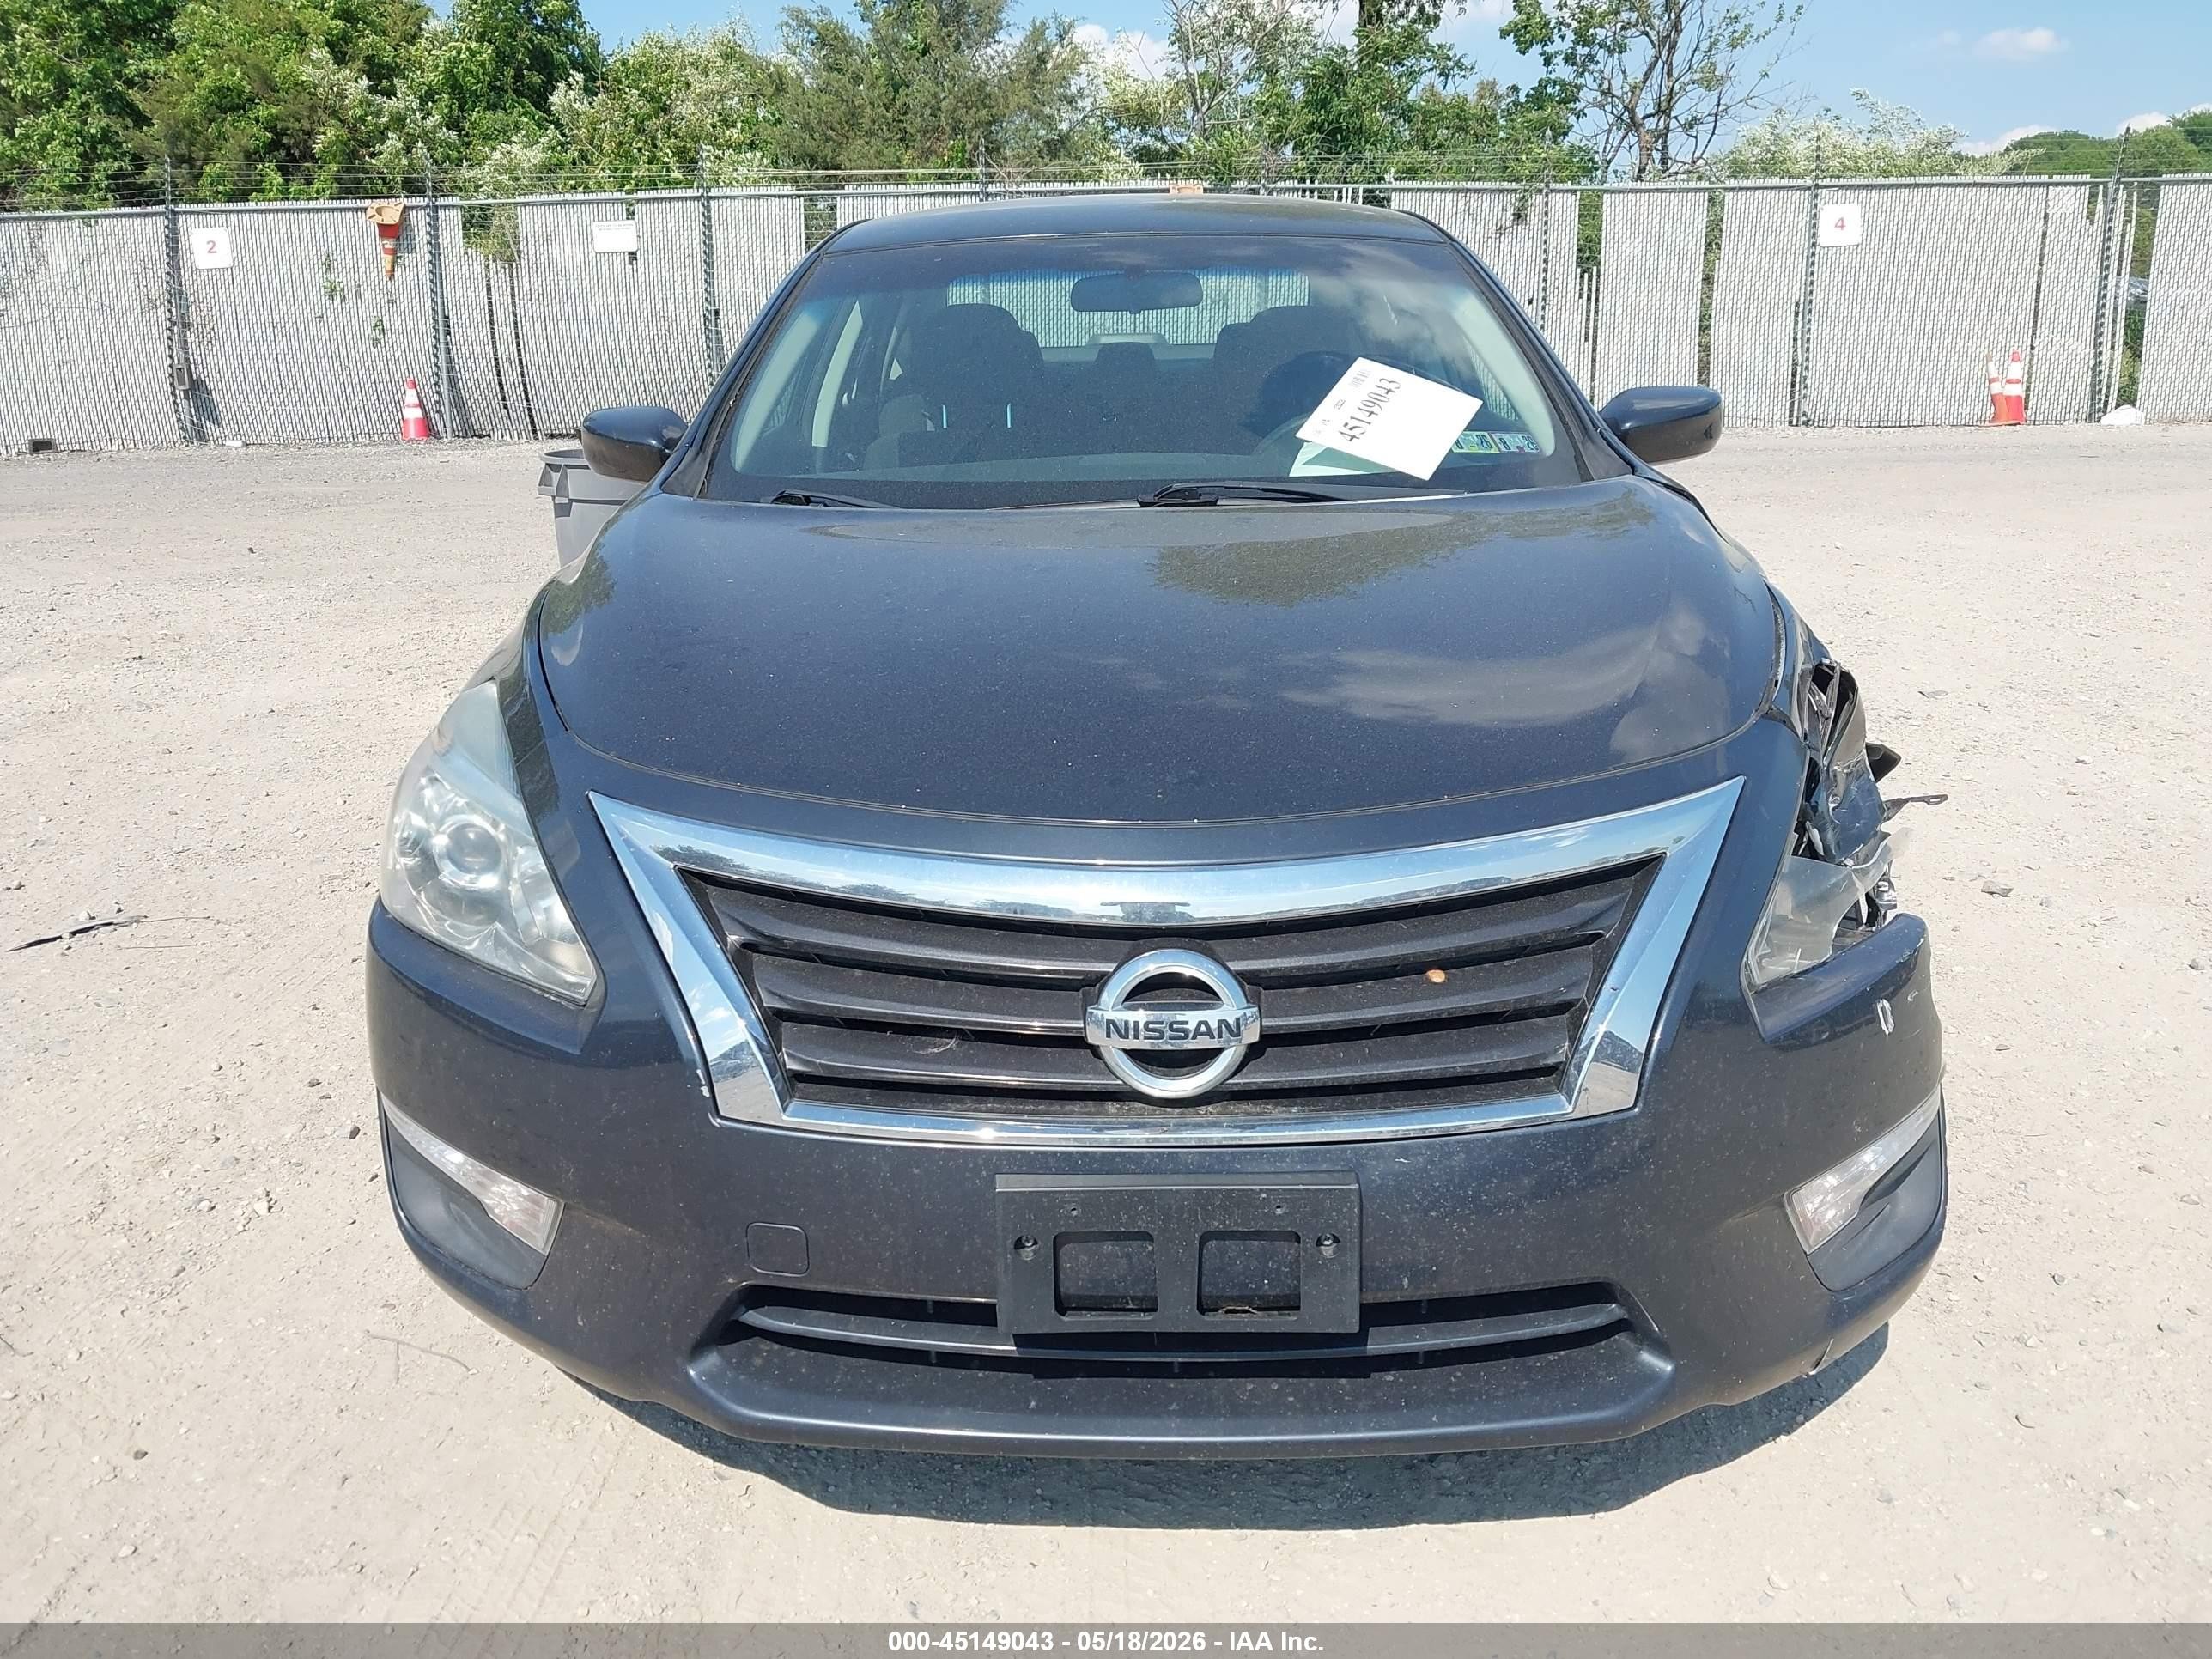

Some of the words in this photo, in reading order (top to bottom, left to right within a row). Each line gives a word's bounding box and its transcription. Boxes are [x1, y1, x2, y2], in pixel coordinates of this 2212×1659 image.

[1834, 216, 1846, 231] 4
[206, 240, 217, 254] 2
[1339, 377, 1401, 442] 45149043
[1498, 437, 1511, 450] 8
[1105, 1017, 1242, 1041] NISSAN
